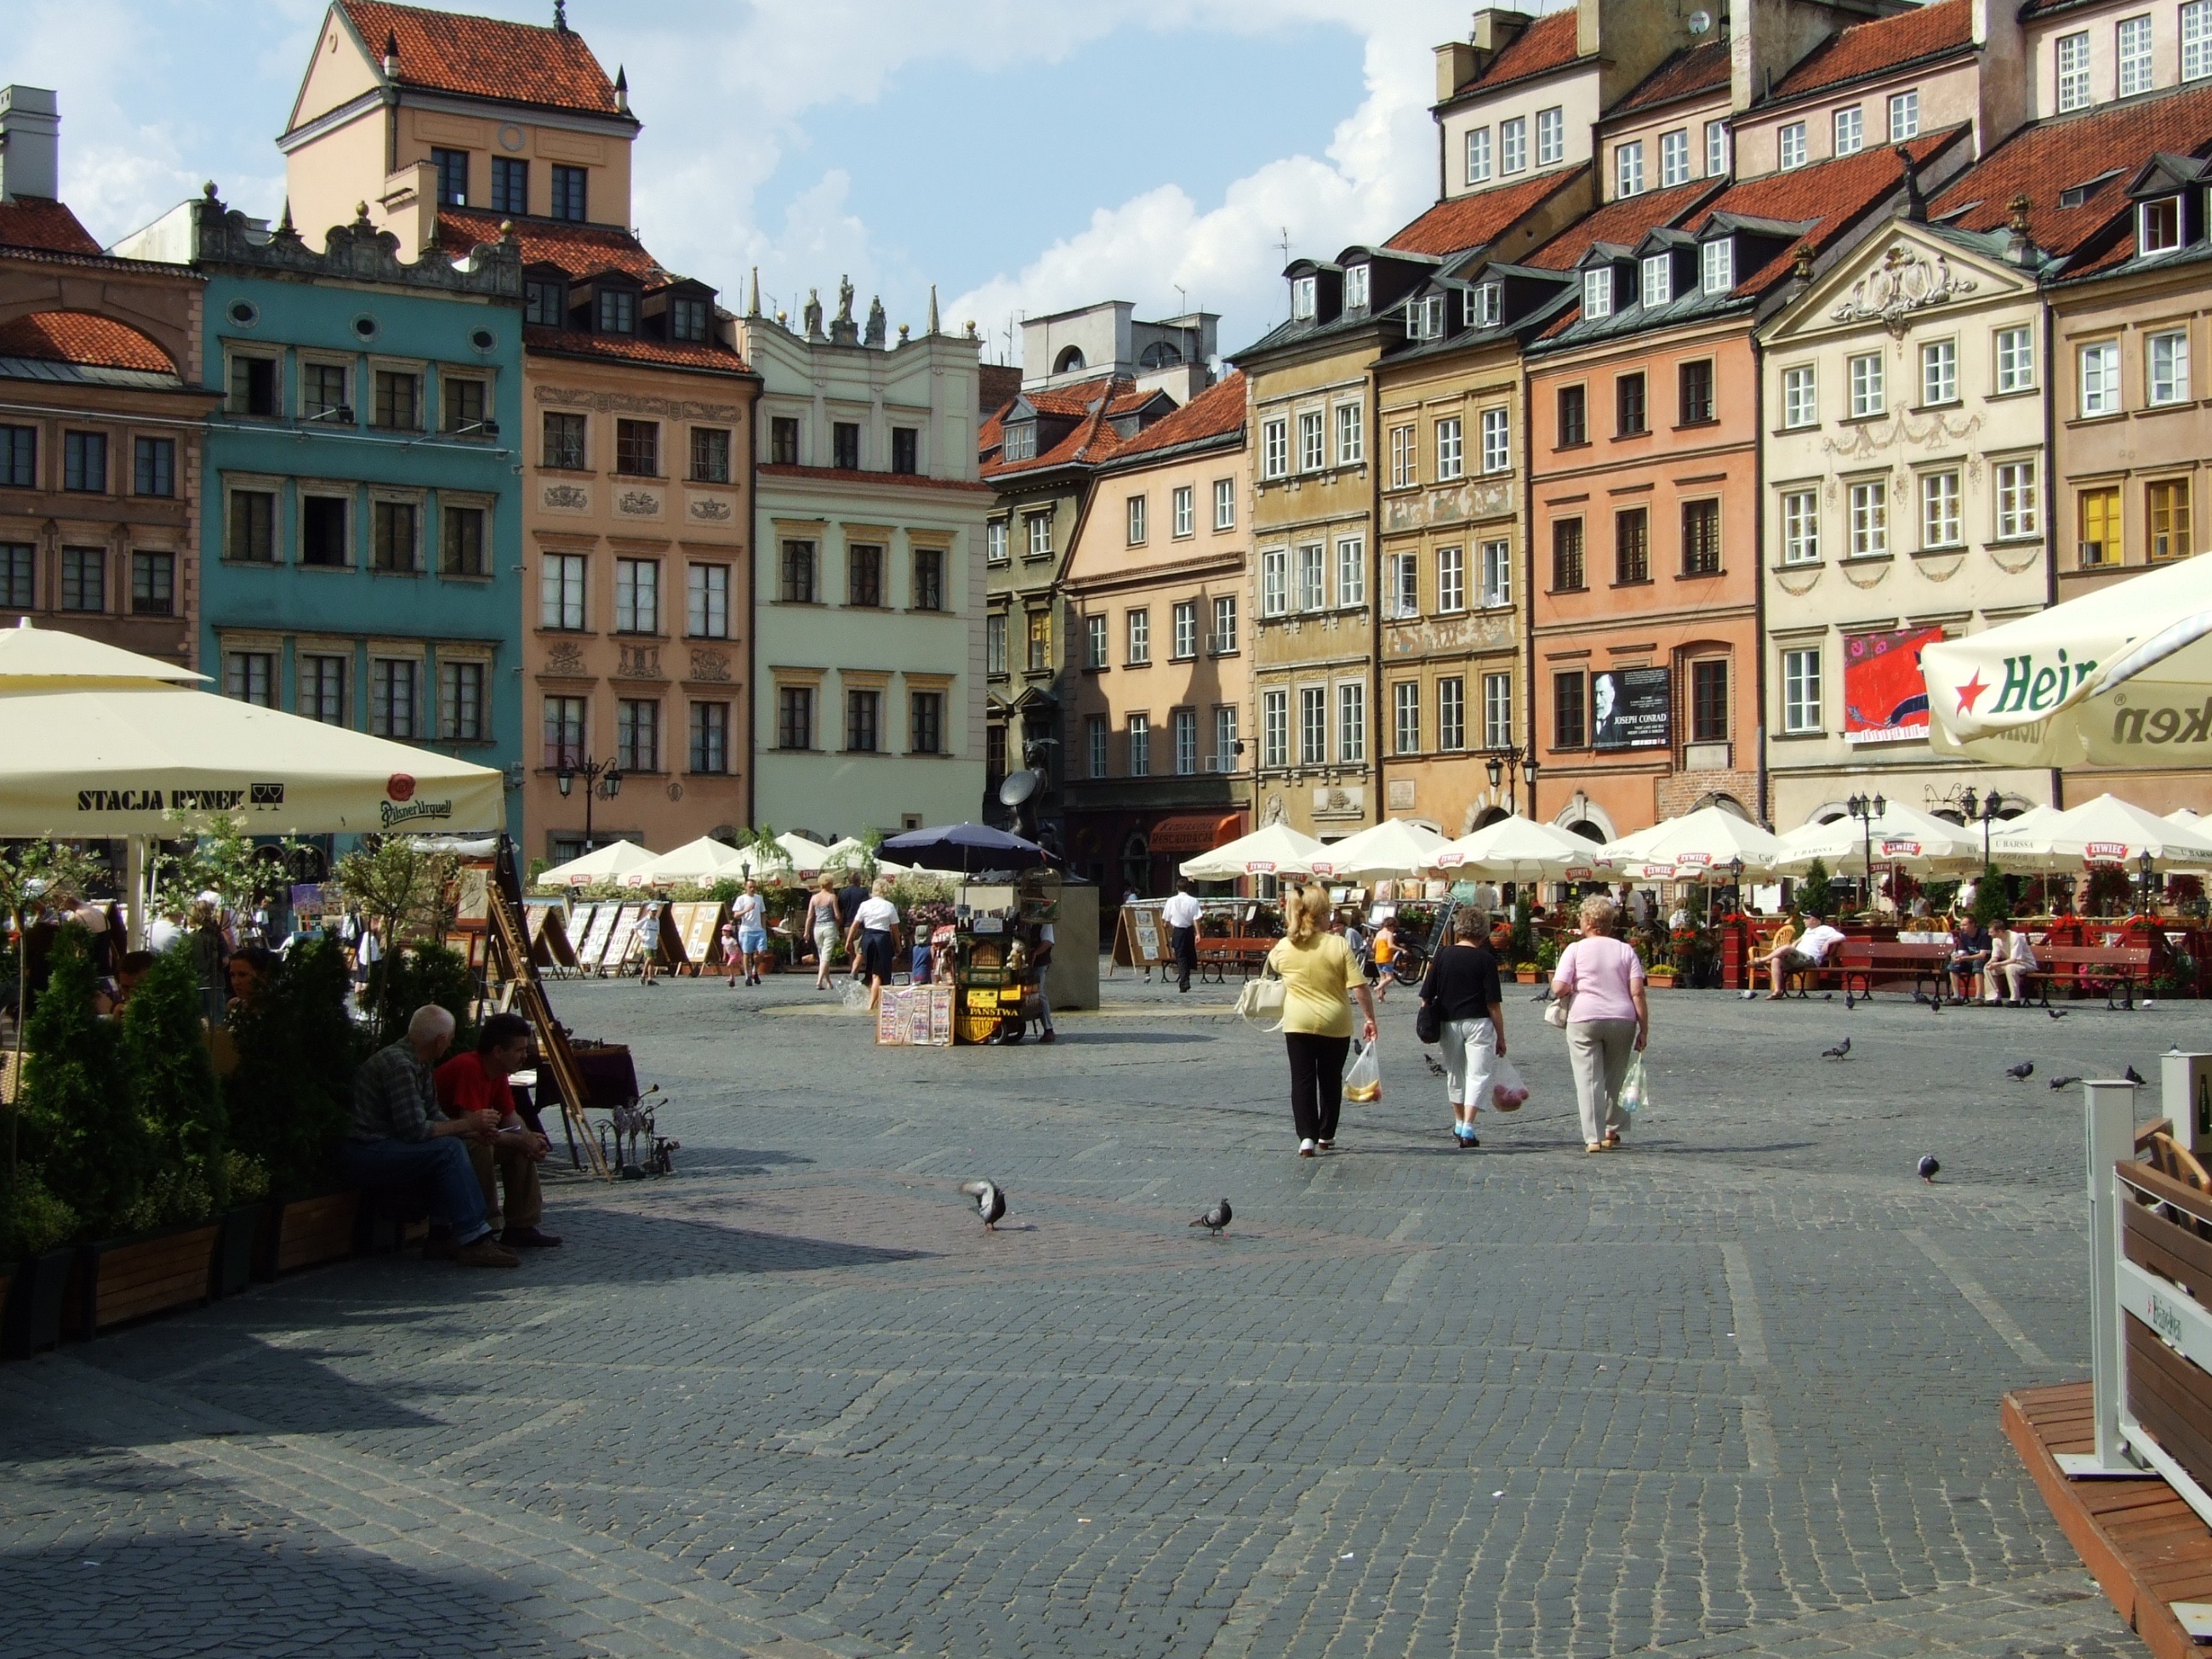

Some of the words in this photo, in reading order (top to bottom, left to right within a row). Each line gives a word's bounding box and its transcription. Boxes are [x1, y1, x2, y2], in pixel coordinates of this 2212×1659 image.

[1614, 715, 1637, 725] JOSEPH
[1639, 713, 1667, 723] CONRAD
[77, 790, 164, 811] STACJA
[171, 790, 246, 811] RYNEK
[380, 800, 417, 830] Pilsner
[414, 799, 452, 820] Urquell
[2188, 849, 2212, 858] BARS
